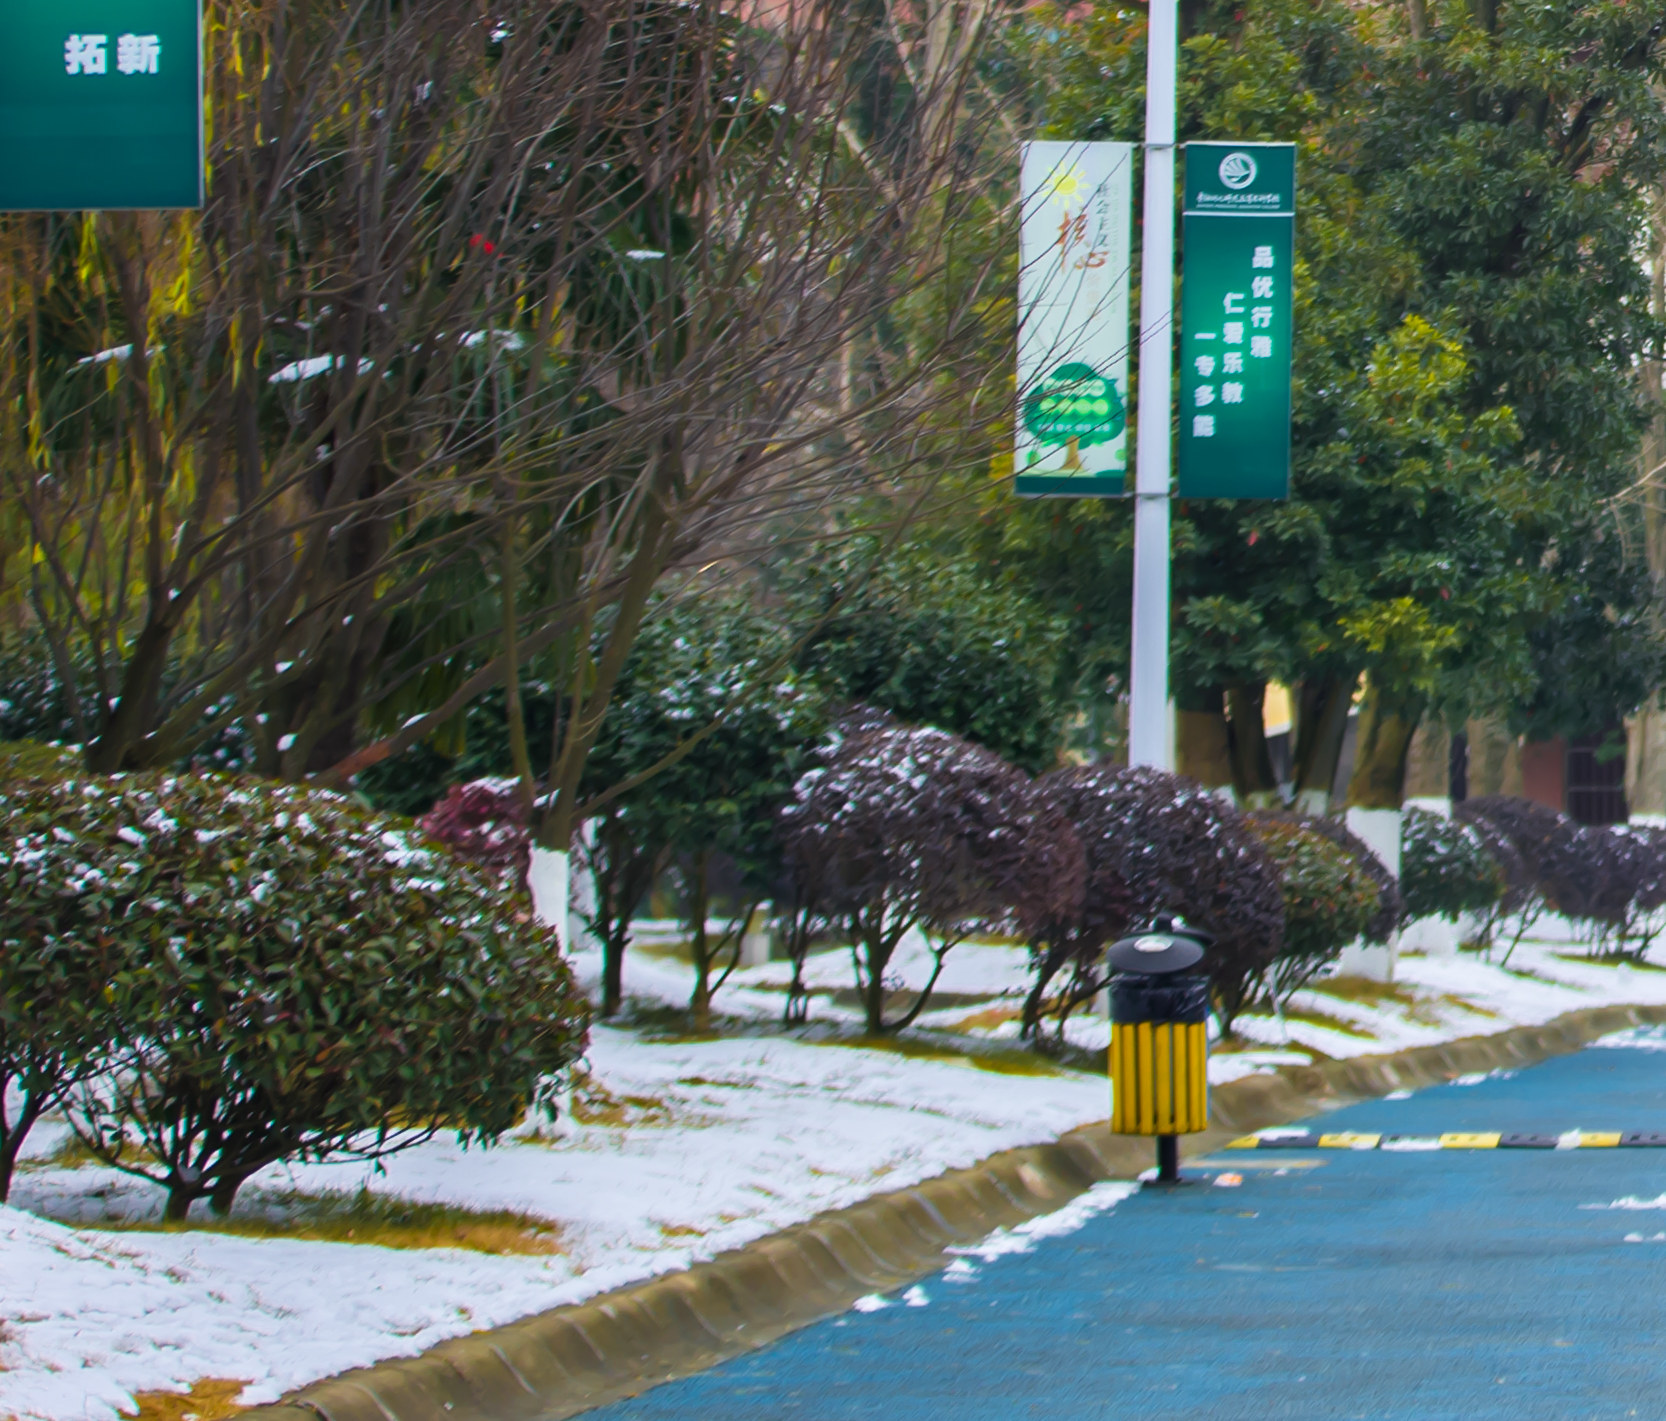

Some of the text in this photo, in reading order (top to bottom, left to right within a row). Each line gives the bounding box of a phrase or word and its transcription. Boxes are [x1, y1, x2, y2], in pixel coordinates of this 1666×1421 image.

[64, 33, 161, 75] 拓新
[1220, 291, 1245, 404] 仁爱乐教
[1250, 245, 1274, 359] 品优行雅
[1192, 331, 1216, 438] 一专多能
